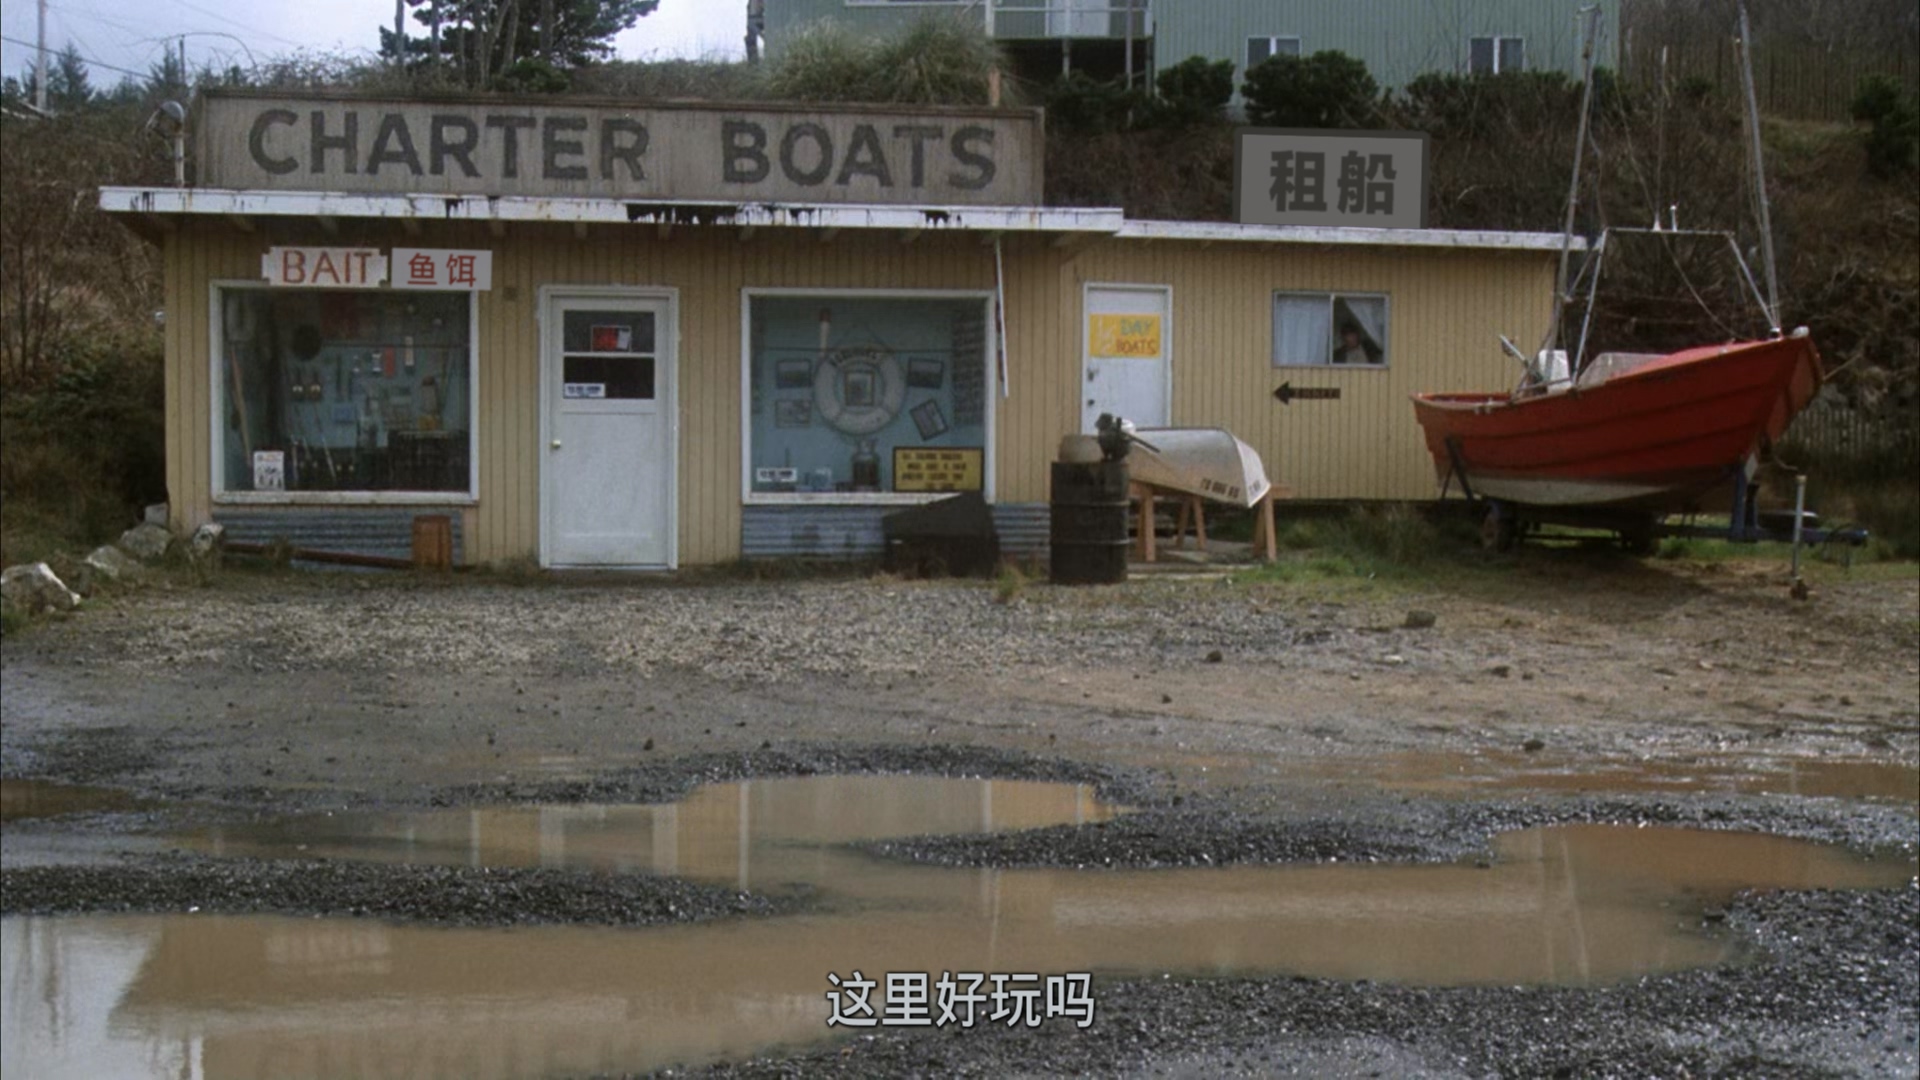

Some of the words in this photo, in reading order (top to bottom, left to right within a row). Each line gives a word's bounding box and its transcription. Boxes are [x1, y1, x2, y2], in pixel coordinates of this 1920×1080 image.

[248, 108, 650, 181] CHARTER
[721, 119, 997, 191] BOATS
[282, 250, 372, 284] BAIT
[1121, 318, 1152, 336] DAY
[1116, 338, 1157, 355] BOATS
